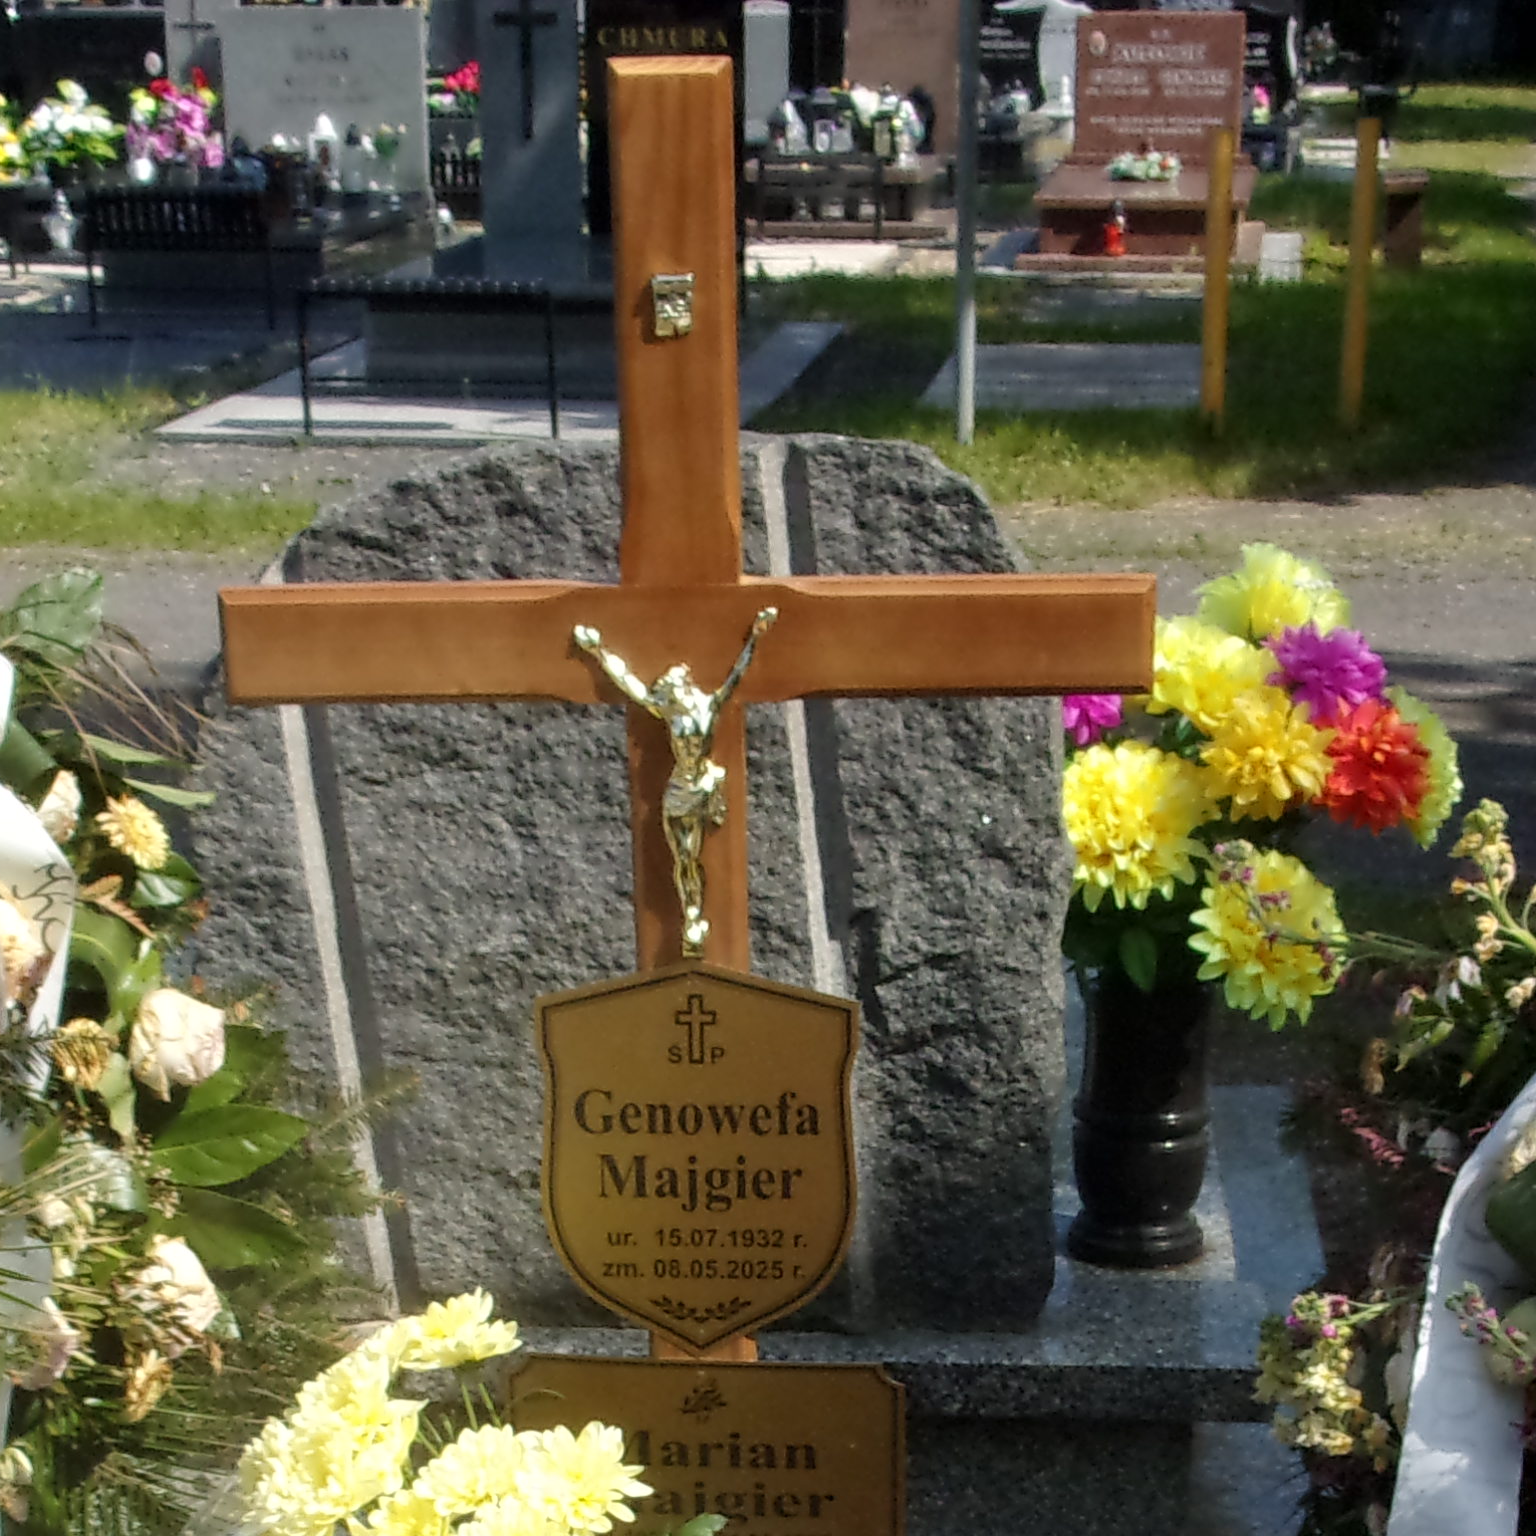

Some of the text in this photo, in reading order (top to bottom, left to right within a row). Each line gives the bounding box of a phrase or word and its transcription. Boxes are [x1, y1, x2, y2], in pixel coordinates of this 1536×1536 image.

[573, 1088, 821, 1137] Genowefa
[598, 1154, 804, 1213] Majgier
[607, 1231, 638, 1247] ur.
[655, 1227, 784, 1249] 15.07.1932
[602, 1262, 645, 1278] zm.
[653, 1259, 784, 1280] 08.05.2025
[634, 1481, 838, 1525] ajgier
